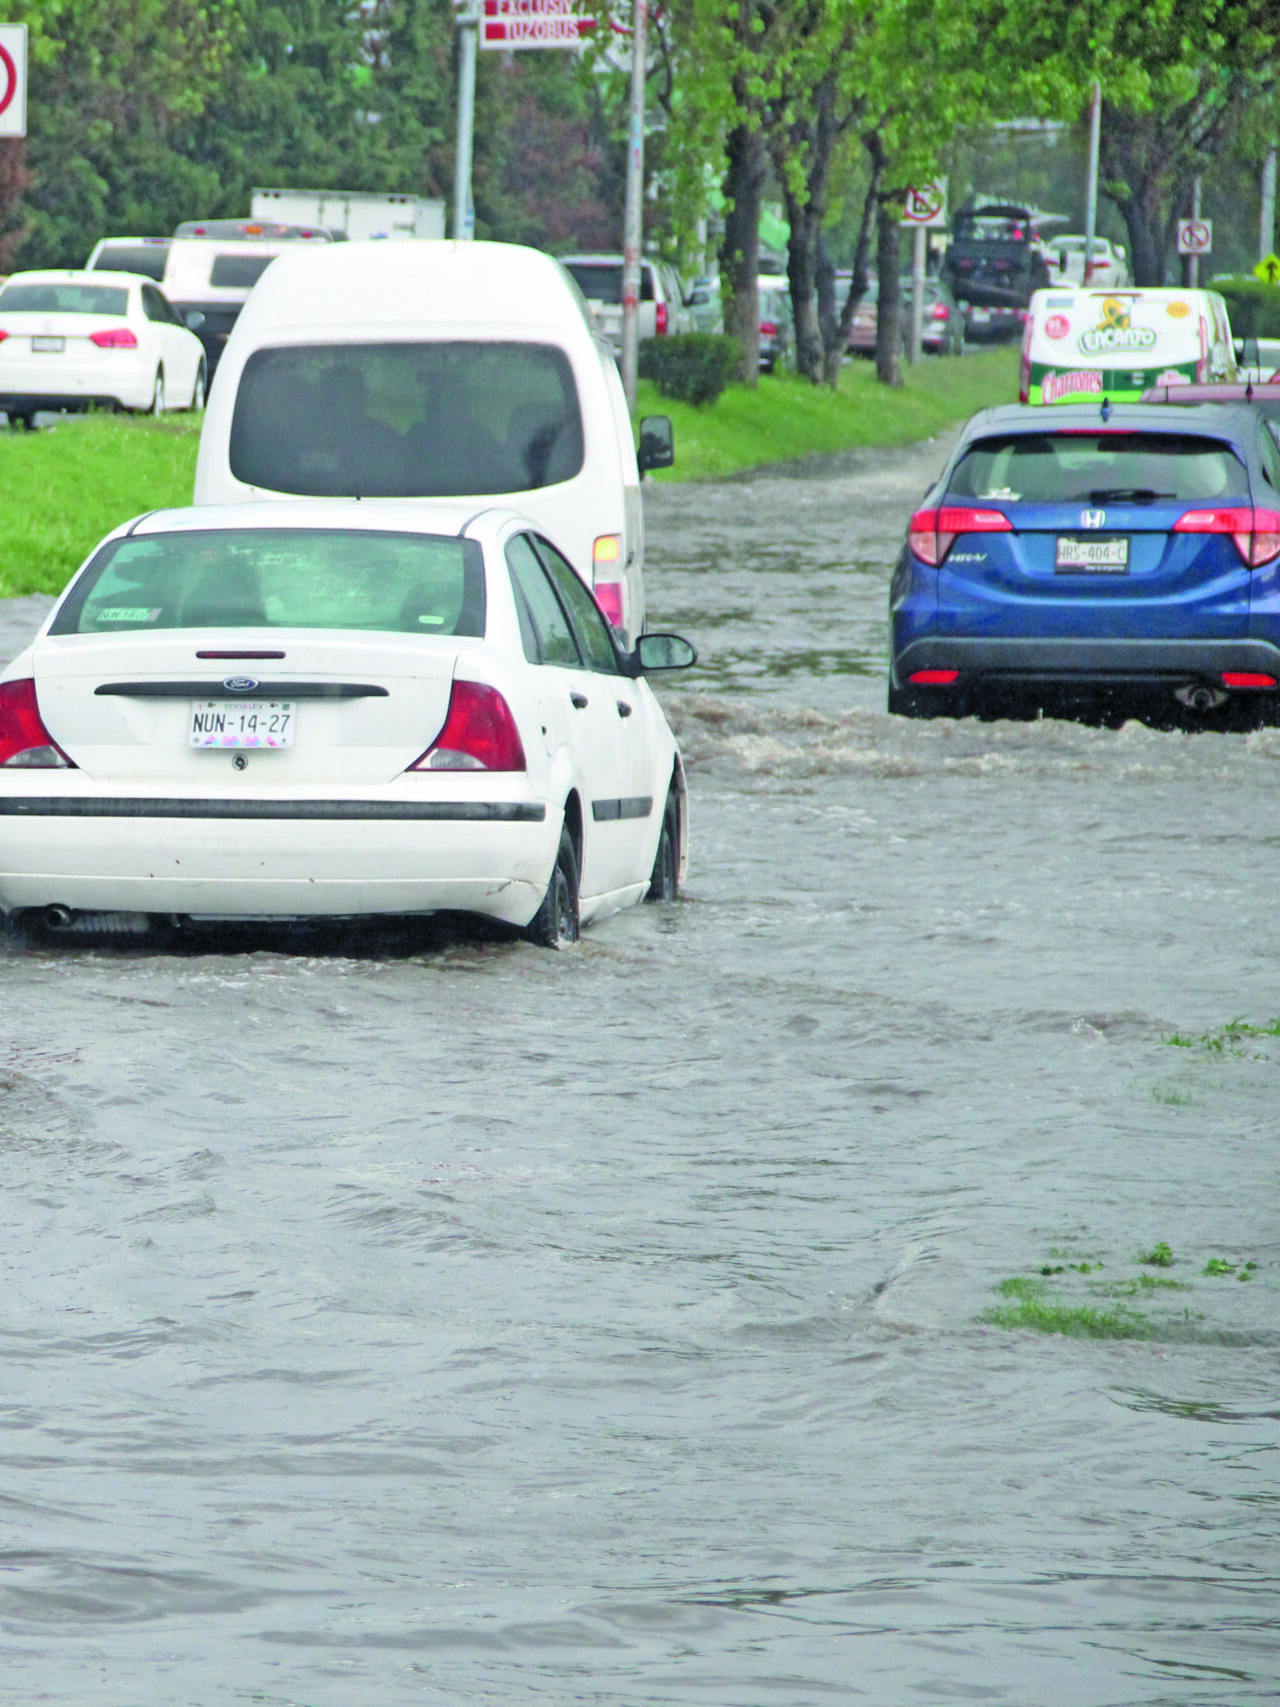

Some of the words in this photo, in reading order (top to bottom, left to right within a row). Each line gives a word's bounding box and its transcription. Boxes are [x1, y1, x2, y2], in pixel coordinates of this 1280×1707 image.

[506, 20, 579, 40] TUZOBUS
[1058, 545, 1125, 561] HRS-404-C
[230, 679, 250, 688] Ford
[193, 713, 291, 733] NUN-14-27
